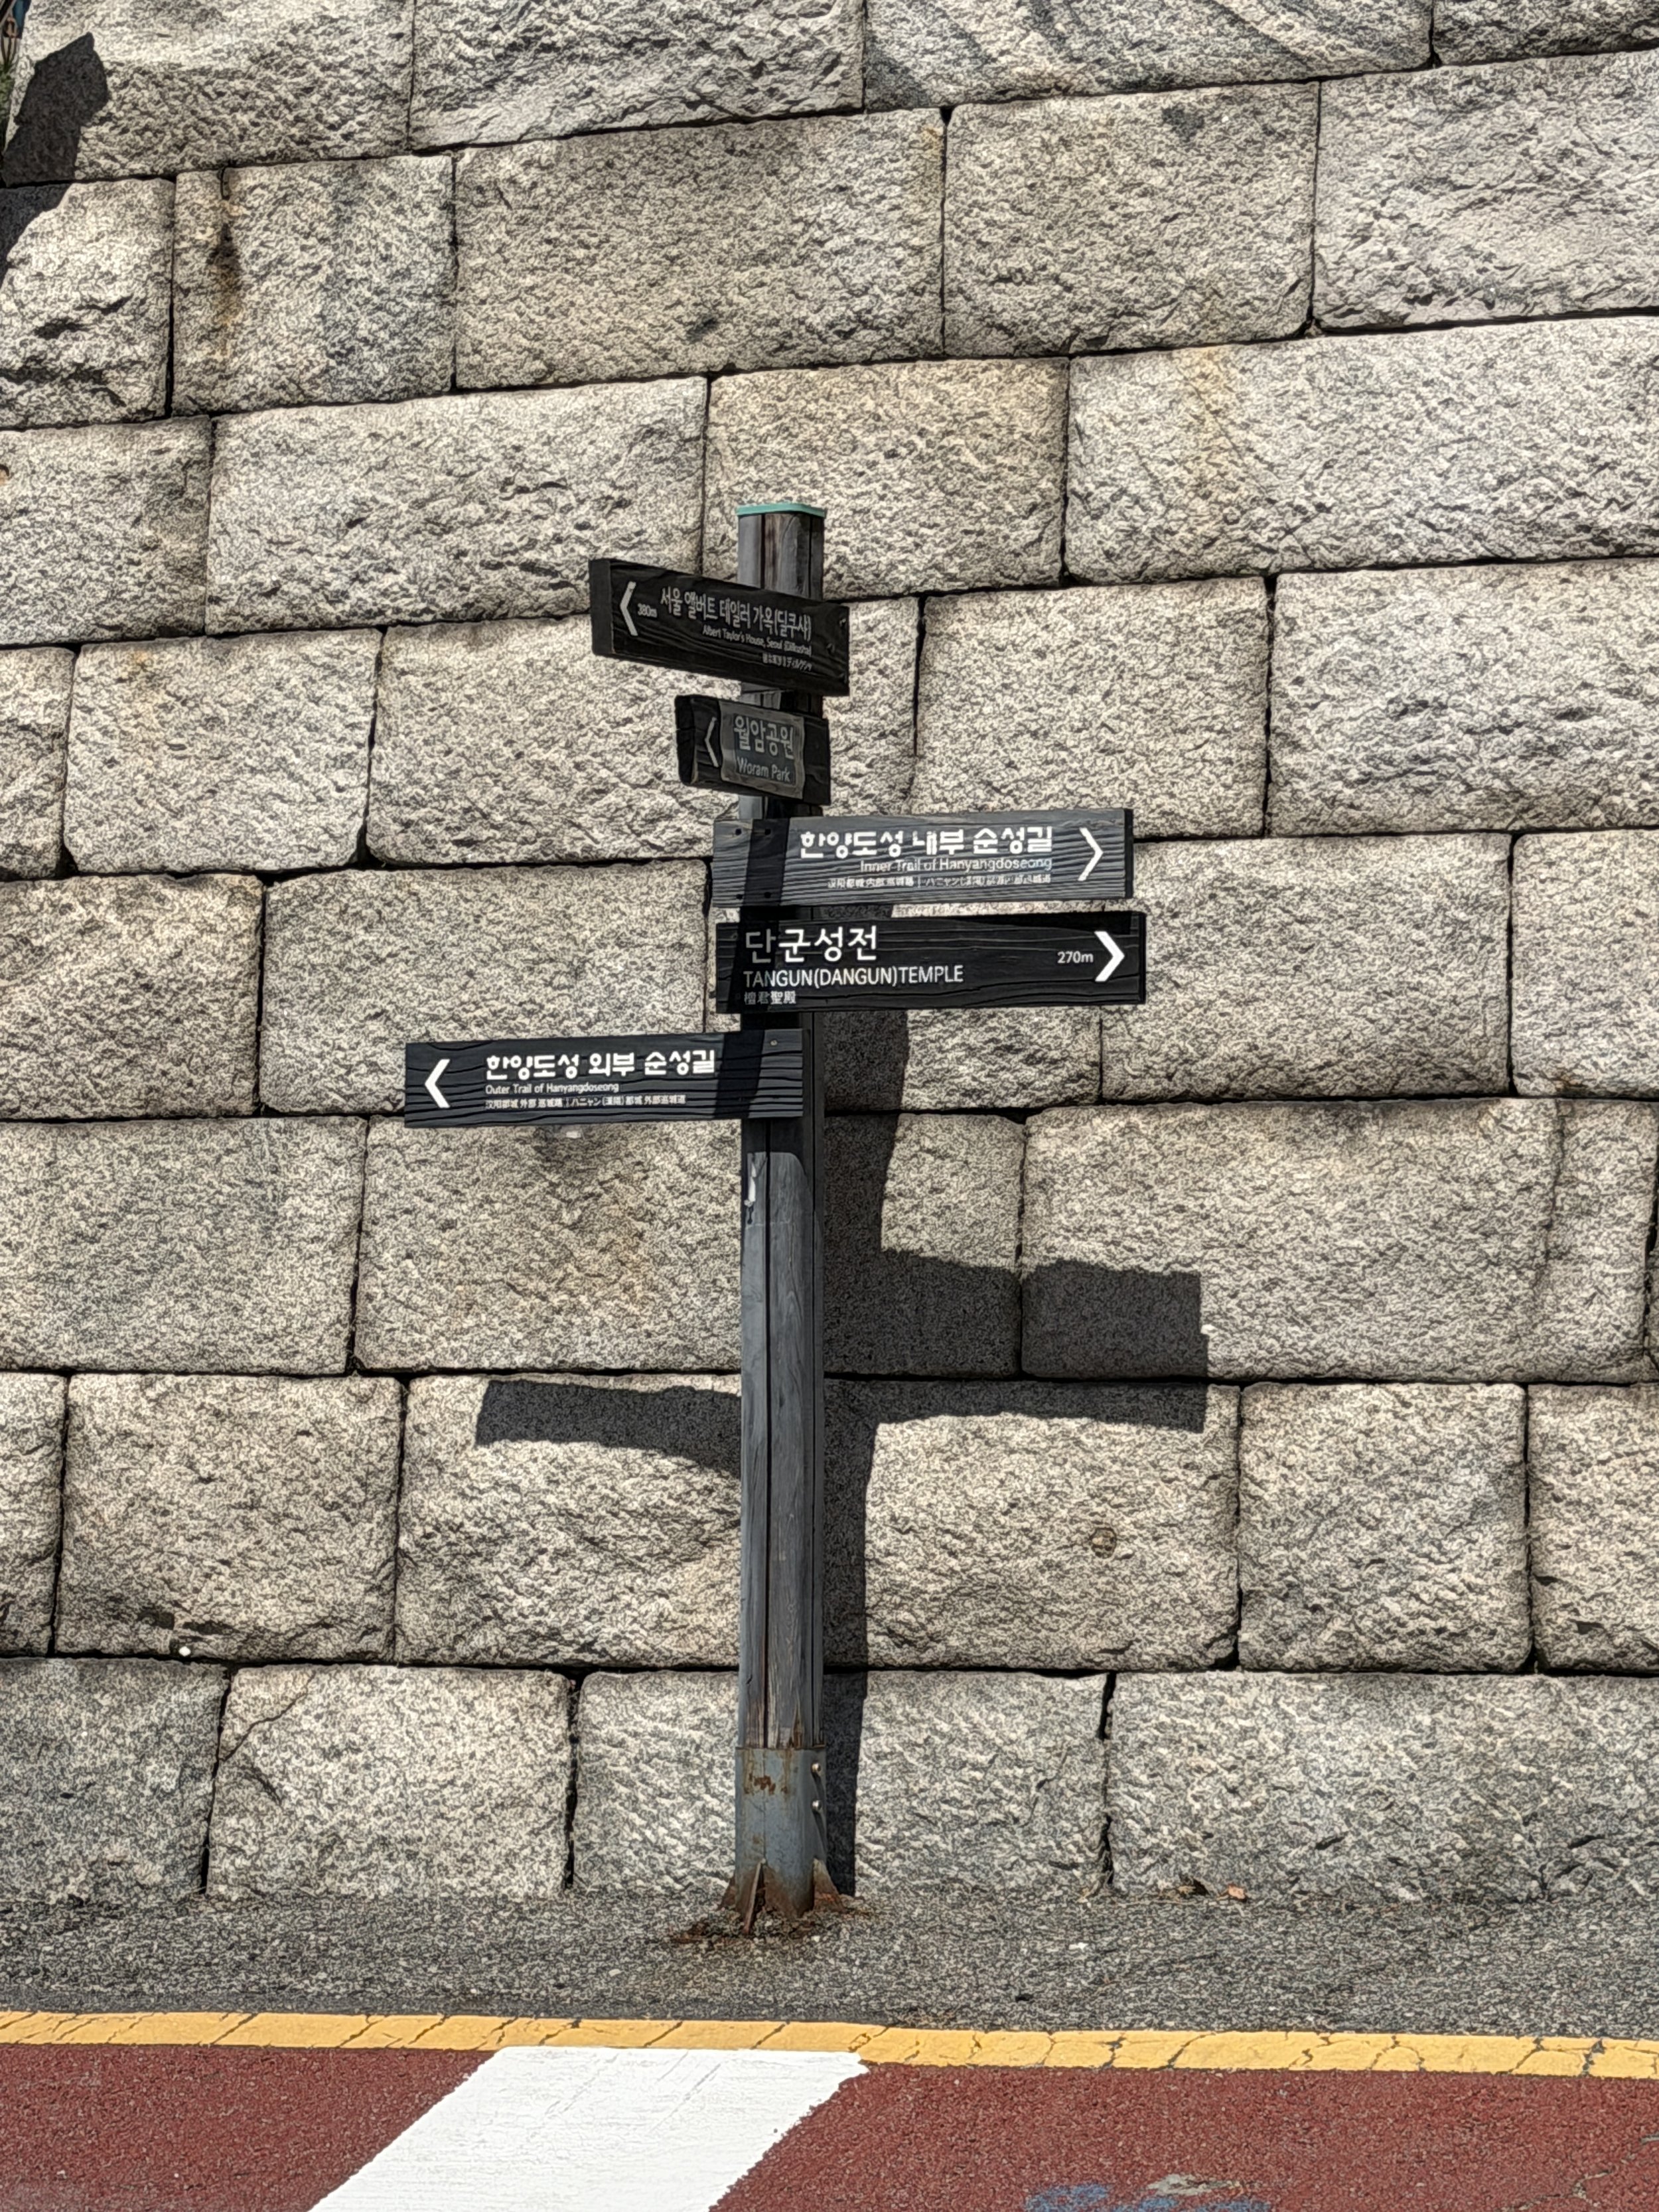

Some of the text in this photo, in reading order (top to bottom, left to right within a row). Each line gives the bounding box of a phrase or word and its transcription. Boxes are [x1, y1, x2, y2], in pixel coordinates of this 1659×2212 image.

[660, 586, 683, 616] 서울
[684, 591, 718, 621] 앨버트
[719, 597, 750, 628] 테일러
[722, 628, 745, 642] Taylor's
[734, 715, 794, 759] 월암공원
[737, 757, 790, 782] Woram Park
[800, 826, 1052, 859] 한양도성 내부 순성길
[861, 857, 1052, 873] Inner Trail of Hanyangdoseong
[745, 925, 877, 963] 단군성전
[1057, 951, 1094, 964] 270m
[743, 964, 964, 989] TANGUN(DANGUN)TEMPLE
[486, 1049, 715, 1080] 한양도성 외부 순성길
[486, 1082, 619, 1094] Outer Trail of Hanyangdoseong
